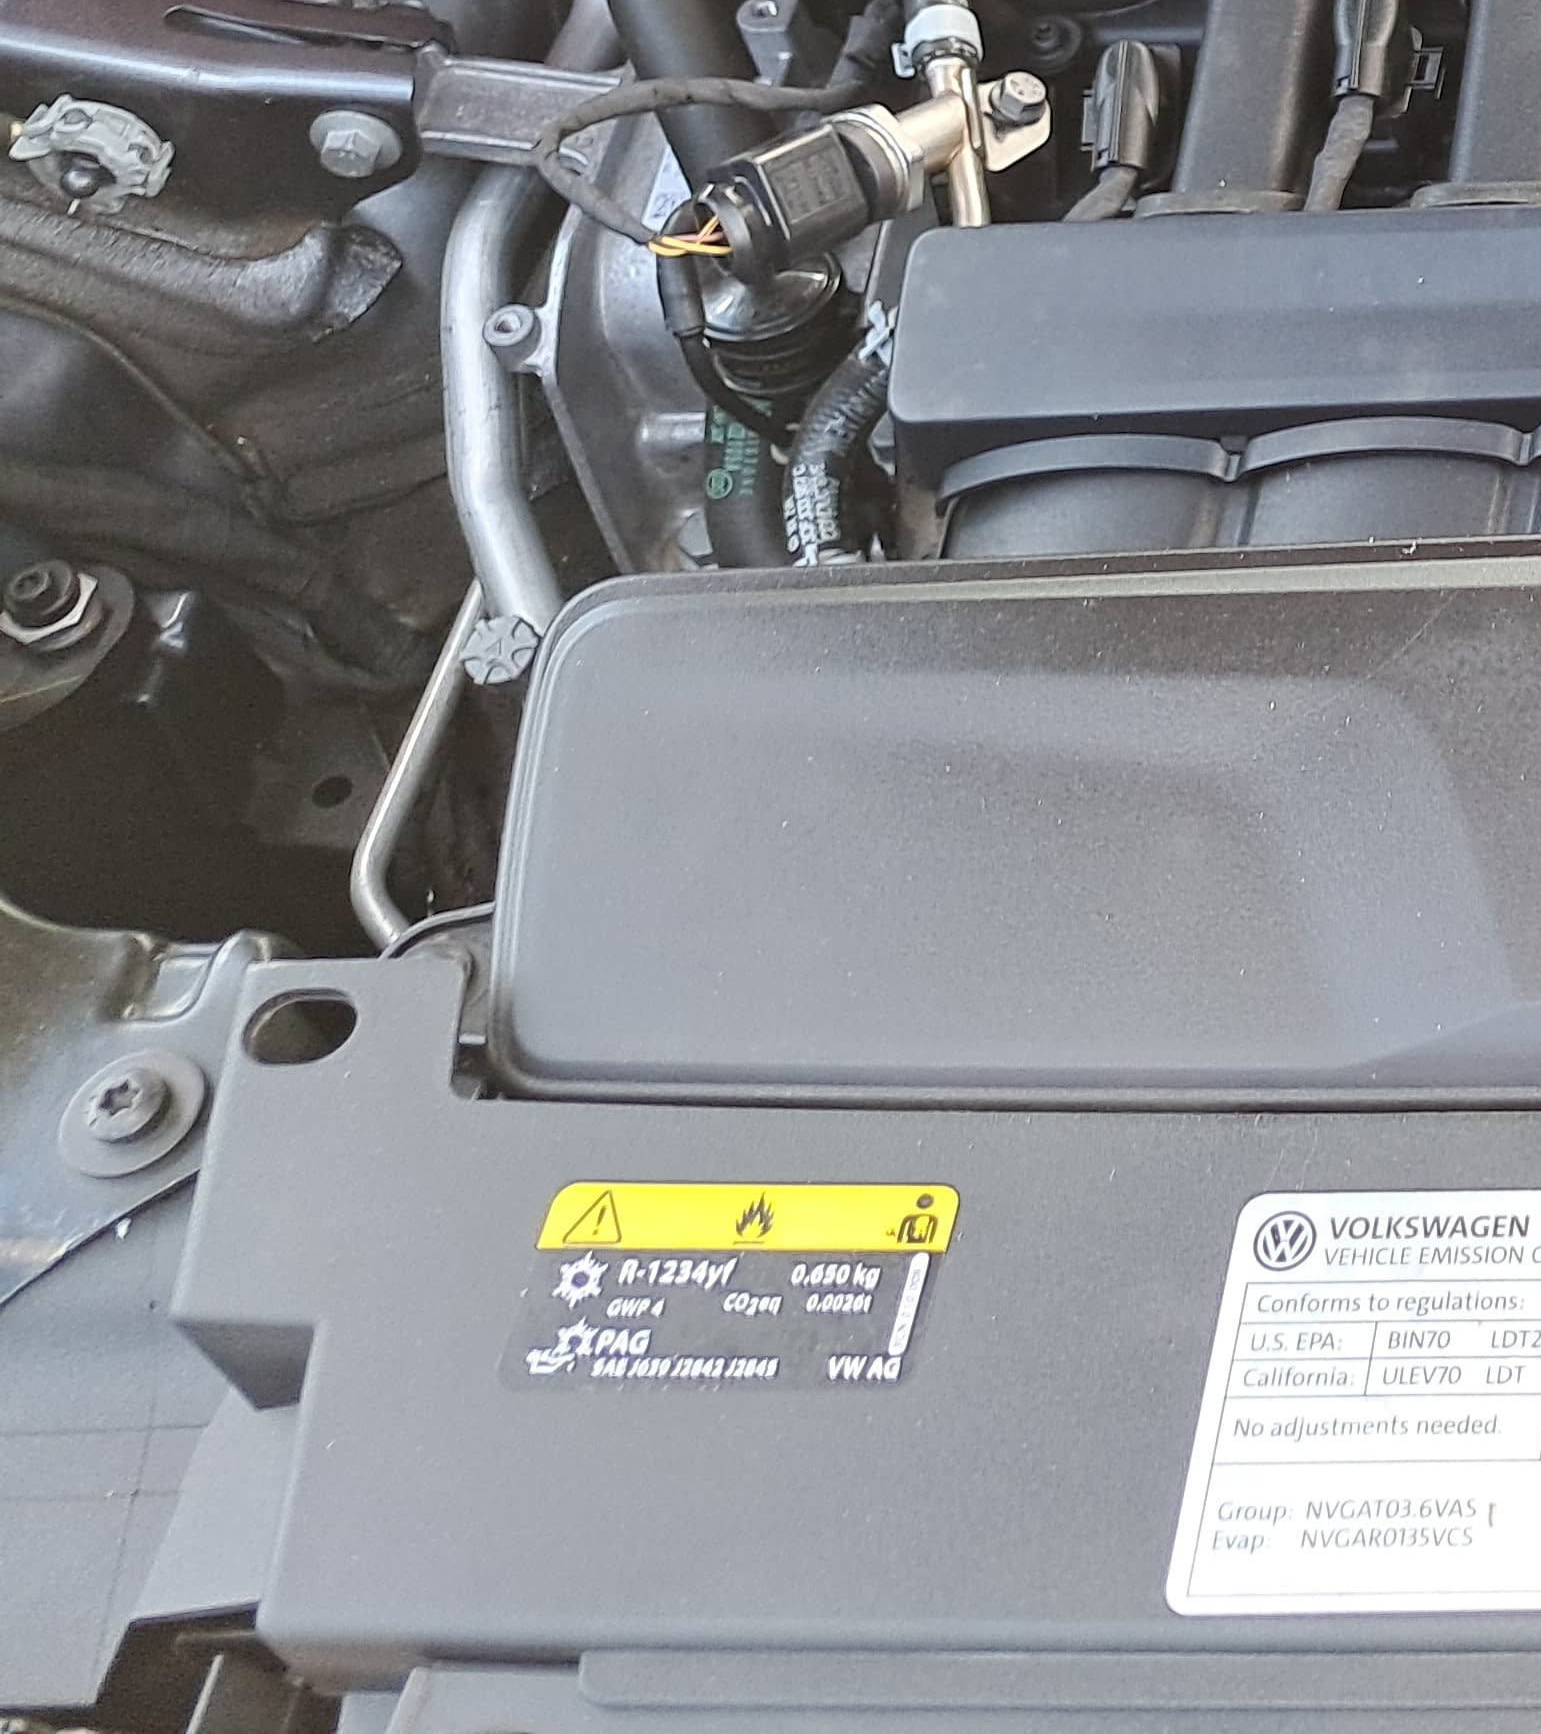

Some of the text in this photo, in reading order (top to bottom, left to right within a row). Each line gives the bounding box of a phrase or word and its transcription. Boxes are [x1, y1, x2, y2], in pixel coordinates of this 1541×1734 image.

[1329, 1214, 1531, 1240] VOLKSWAGEN
[1324, 1245, 1411, 1267] VEHICLE
[1418, 1244, 1525, 1266] EMISSION
[617, 1257, 738, 1290] R-1234yf
[852, 1261, 881, 1291] kg
[606, 1297, 652, 1317] GWP
[650, 1297, 666, 1317] 4
[1257, 1291, 1526, 1317] Conforms to regulations:
[594, 1328, 652, 1356] PAG
[1250, 1331, 1289, 1352] U.S.
[1295, 1331, 1343, 1352] EPA:
[1387, 1329, 1451, 1350] BIN70
[590, 1356, 628, 1377] SAE
[827, 1355, 868, 1380] VW
[866, 1355, 902, 1380] AG
[1242, 1365, 1526, 1388] California: ULEV70 LDT
[1232, 1414, 1502, 1443] No adjustments needed.
[1217, 1498, 1477, 1526] Group: NVGAT03.6VAS
